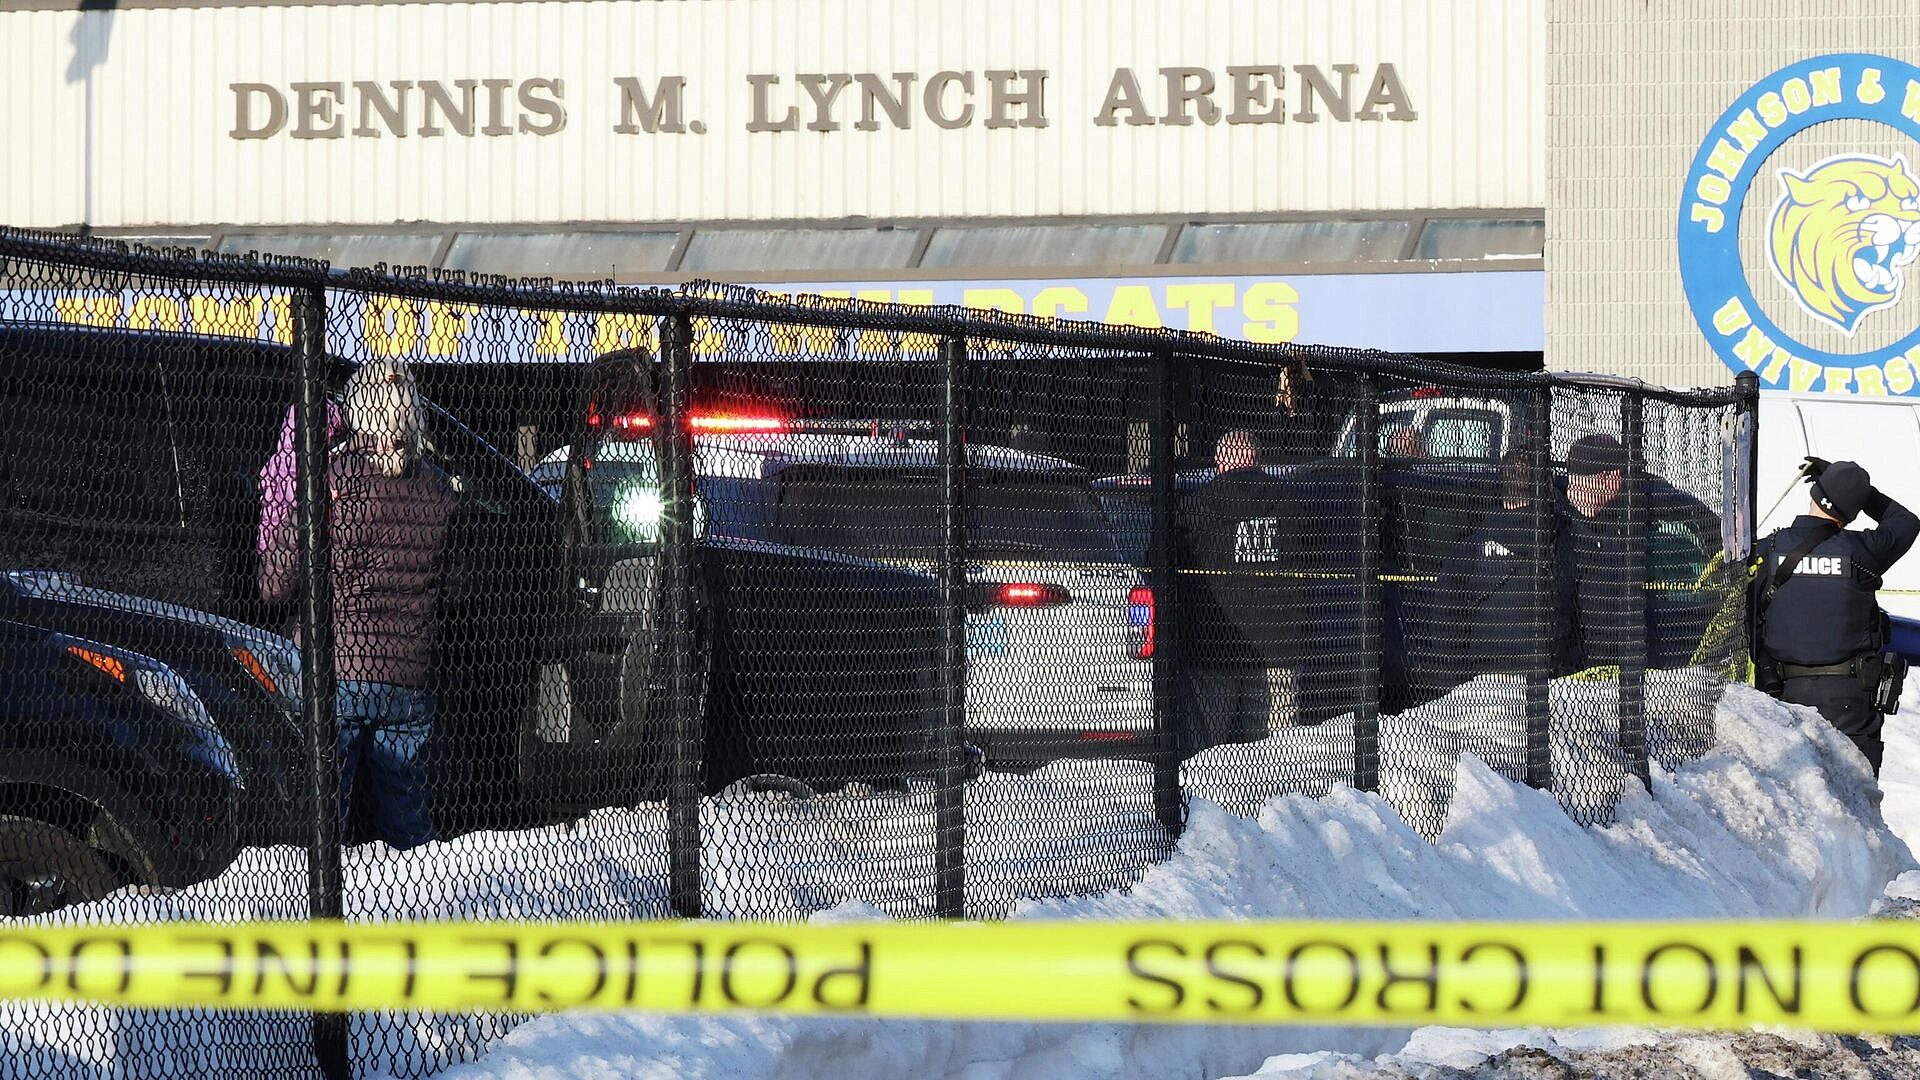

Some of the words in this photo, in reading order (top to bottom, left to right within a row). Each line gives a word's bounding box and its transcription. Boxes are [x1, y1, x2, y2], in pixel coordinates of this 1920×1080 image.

[229, 78, 567, 139] DENNIS
[613, 76, 707, 134] M.
[746, 69, 1050, 132] LYNCH
[1093, 62, 1418, 126] ARENA
[1691, 67, 1842, 233] JOHNSON
[1856, 67, 1886, 105] &
[172, 936, 417, 998] LINE
[456, 937, 872, 1009] POLICE
[1125, 939, 1530, 1016] CROSS
[1562, 942, 1803, 1016] NOT
